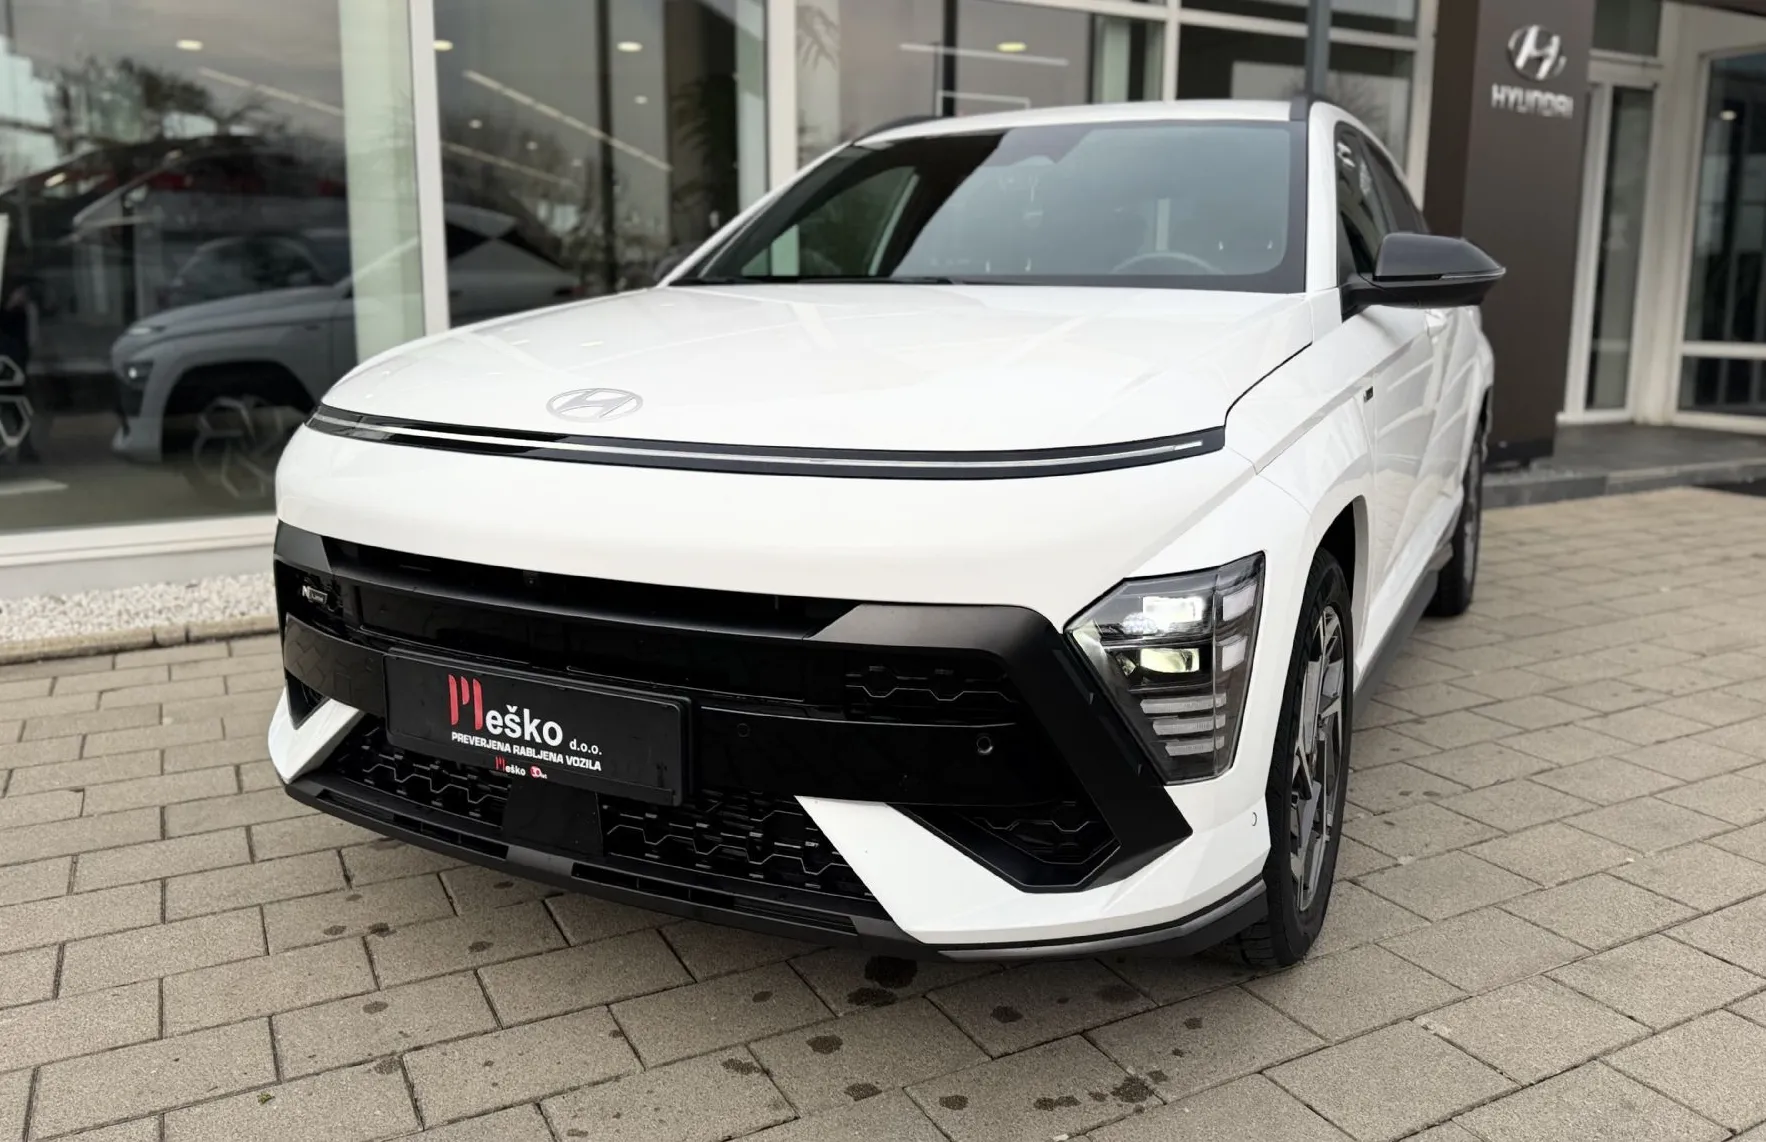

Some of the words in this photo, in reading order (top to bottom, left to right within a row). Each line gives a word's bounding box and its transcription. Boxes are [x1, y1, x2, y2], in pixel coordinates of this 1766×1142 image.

[1491, 83, 1574, 118] HYUNDAI
[448, 674, 564, 746] Meško
[569, 738, 602, 755] d.o.o.
[451, 731, 512, 754] PREVERJENA
[513, 744, 564, 764] RABLJENA
[566, 755, 602, 771] VOZILA
